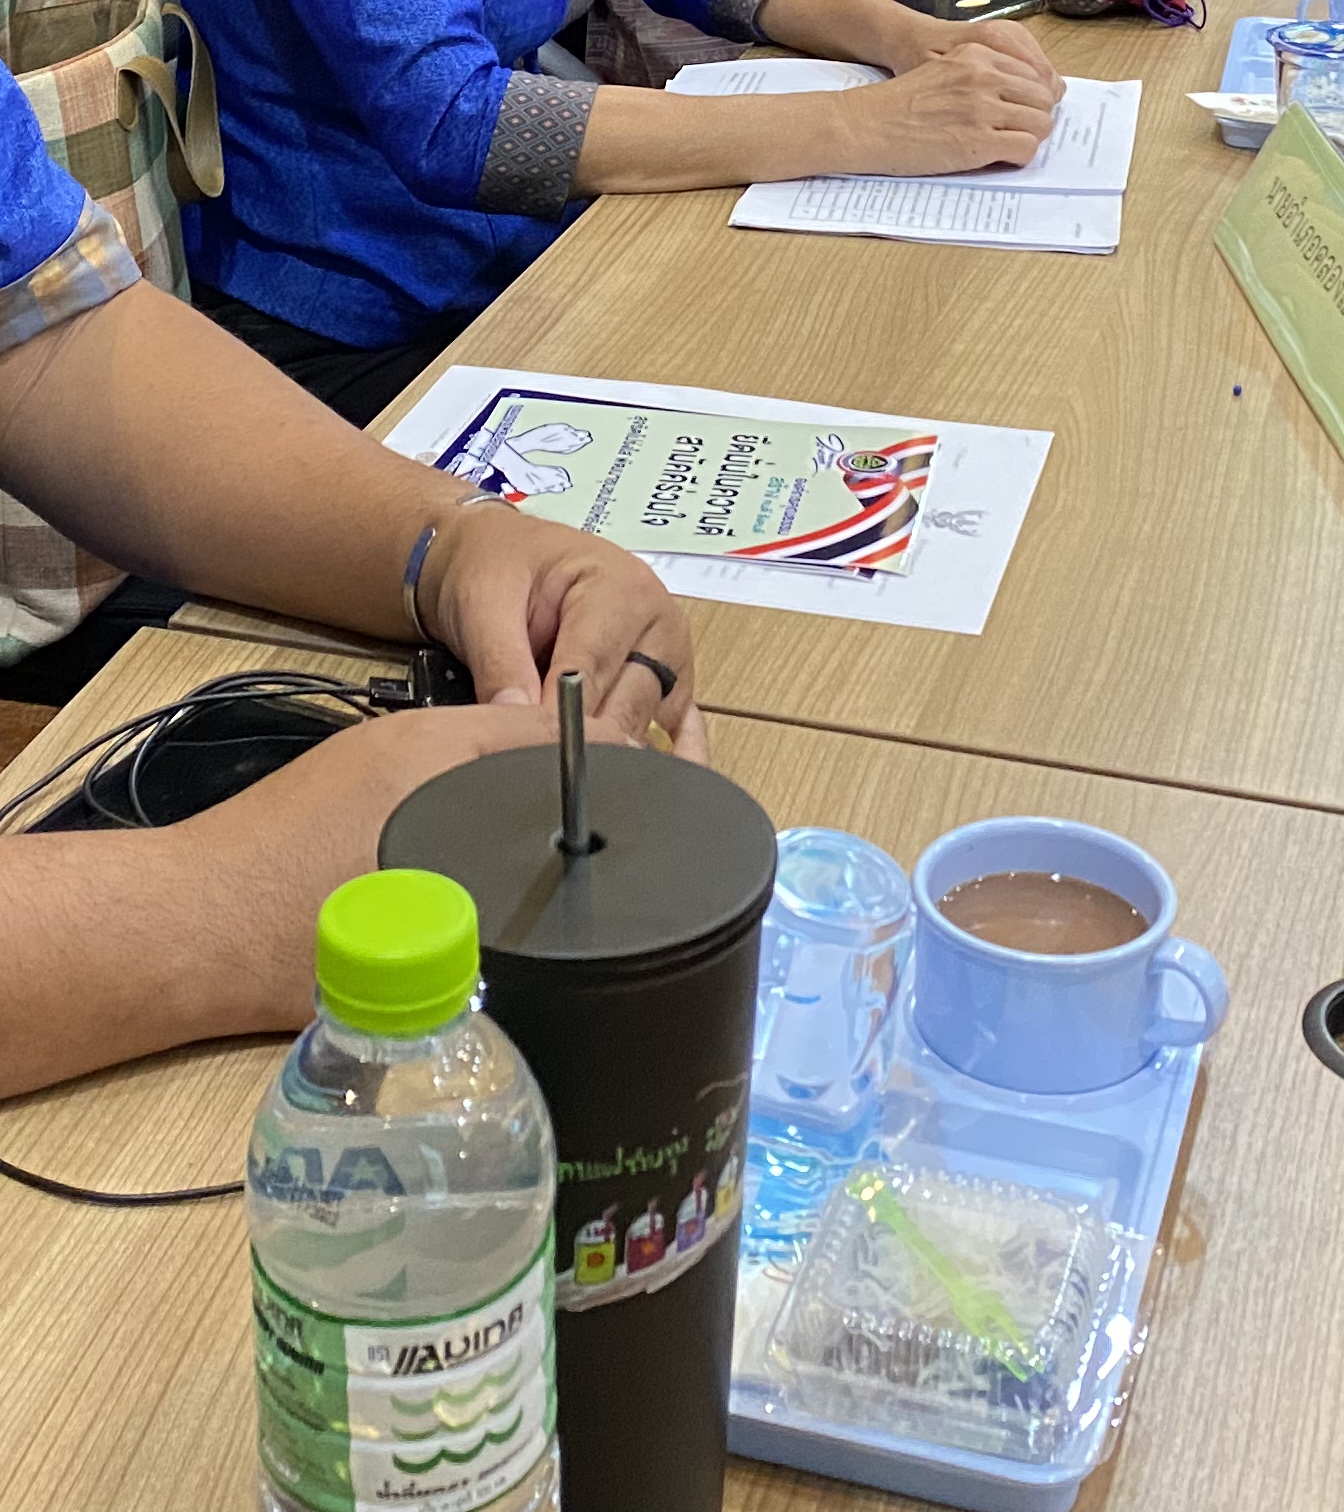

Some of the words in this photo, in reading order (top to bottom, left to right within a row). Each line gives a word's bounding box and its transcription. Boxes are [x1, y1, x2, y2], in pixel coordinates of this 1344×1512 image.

[640, 435, 706, 527] สามัคคีร่วมใจ
[693, 434, 776, 537] ยึดมั่นในความดี
